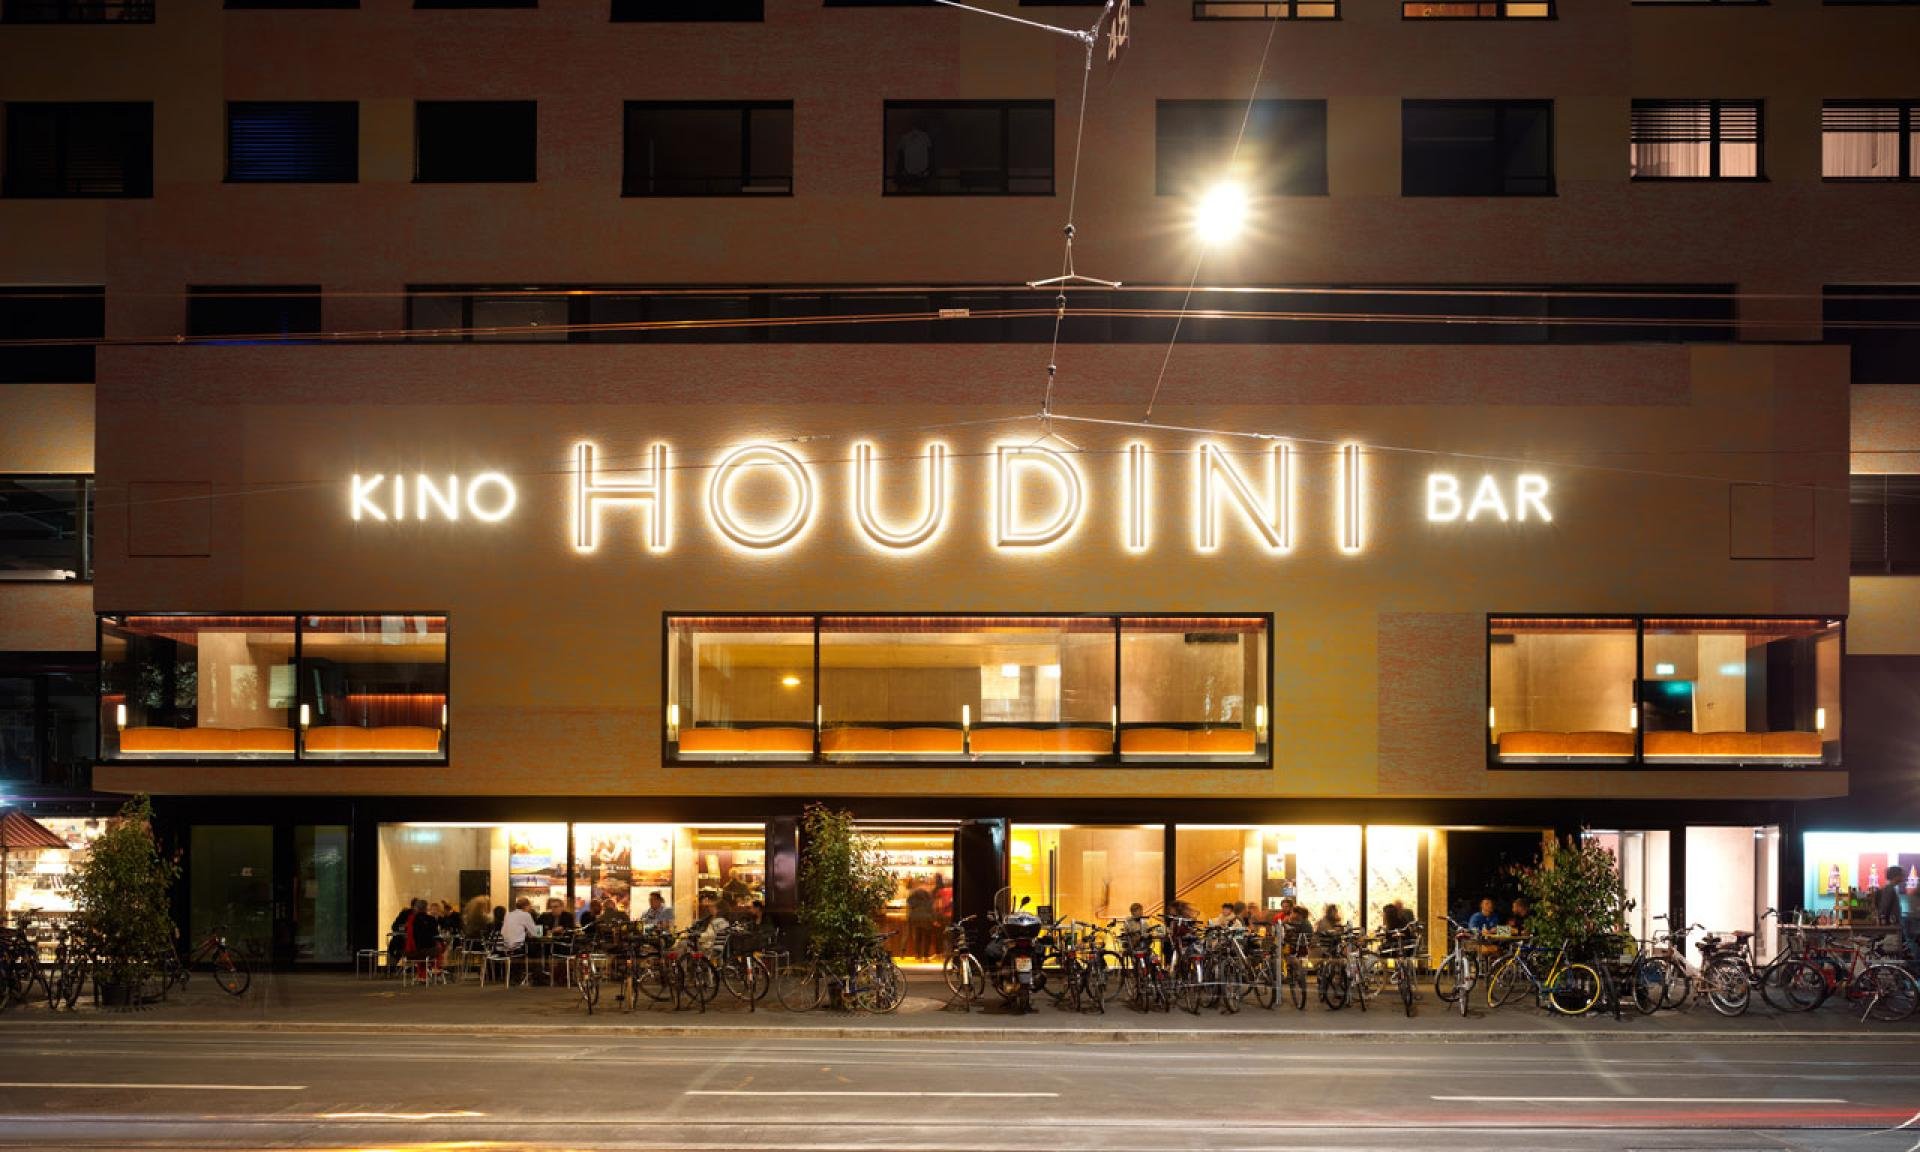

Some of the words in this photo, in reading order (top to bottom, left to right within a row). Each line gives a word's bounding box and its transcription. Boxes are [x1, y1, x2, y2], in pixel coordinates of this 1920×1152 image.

[352, 473, 517, 522] KINO
[572, 439, 1366, 553] HOUDINI
[1426, 473, 1554, 522] BAR
